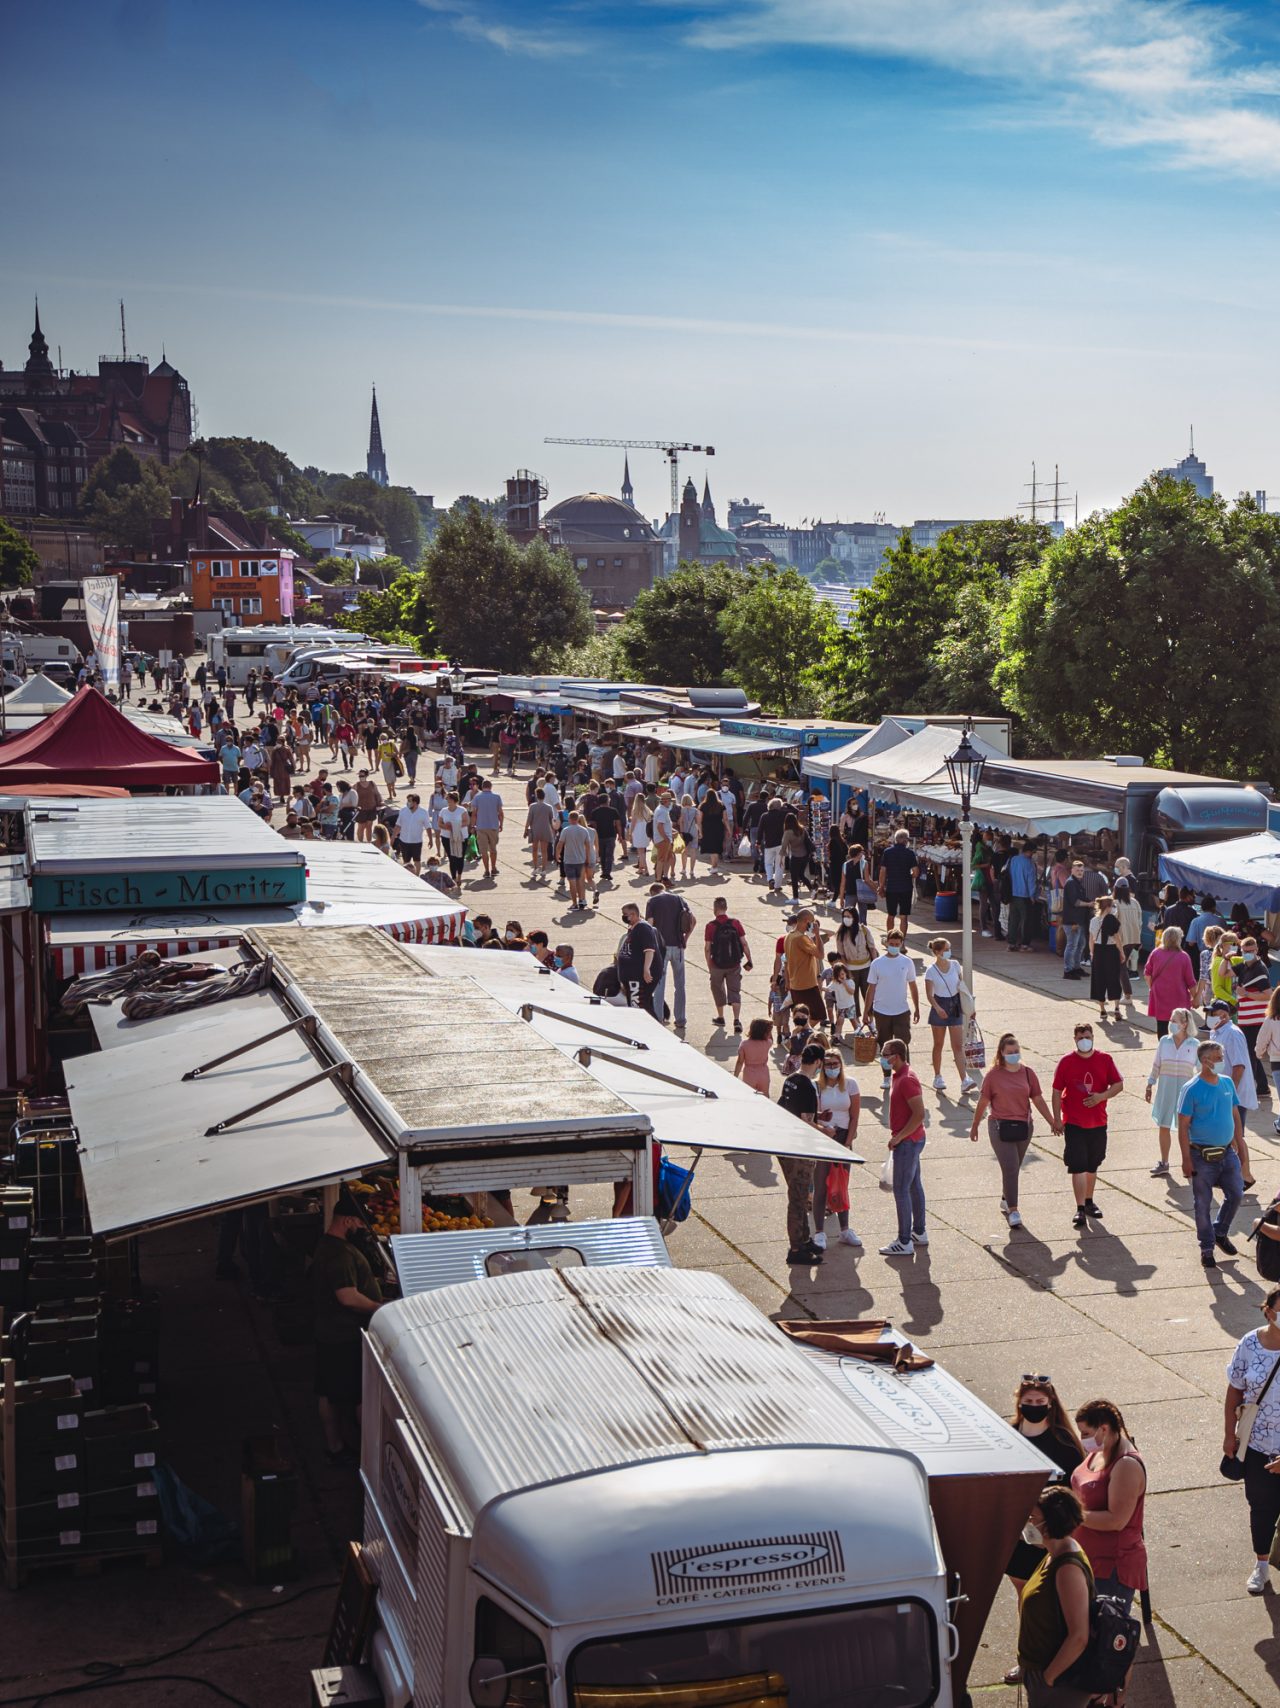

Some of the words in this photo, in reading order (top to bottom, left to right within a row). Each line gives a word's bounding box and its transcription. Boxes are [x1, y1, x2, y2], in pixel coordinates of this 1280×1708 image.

[54, 877, 143, 907] Fisch
[178, 875, 287, 903] Moritz
[681, 1546, 816, 1575] l'espresso!
[712, 1583, 782, 1599] CATERING
[795, 1575, 846, 1589] EVENTS
